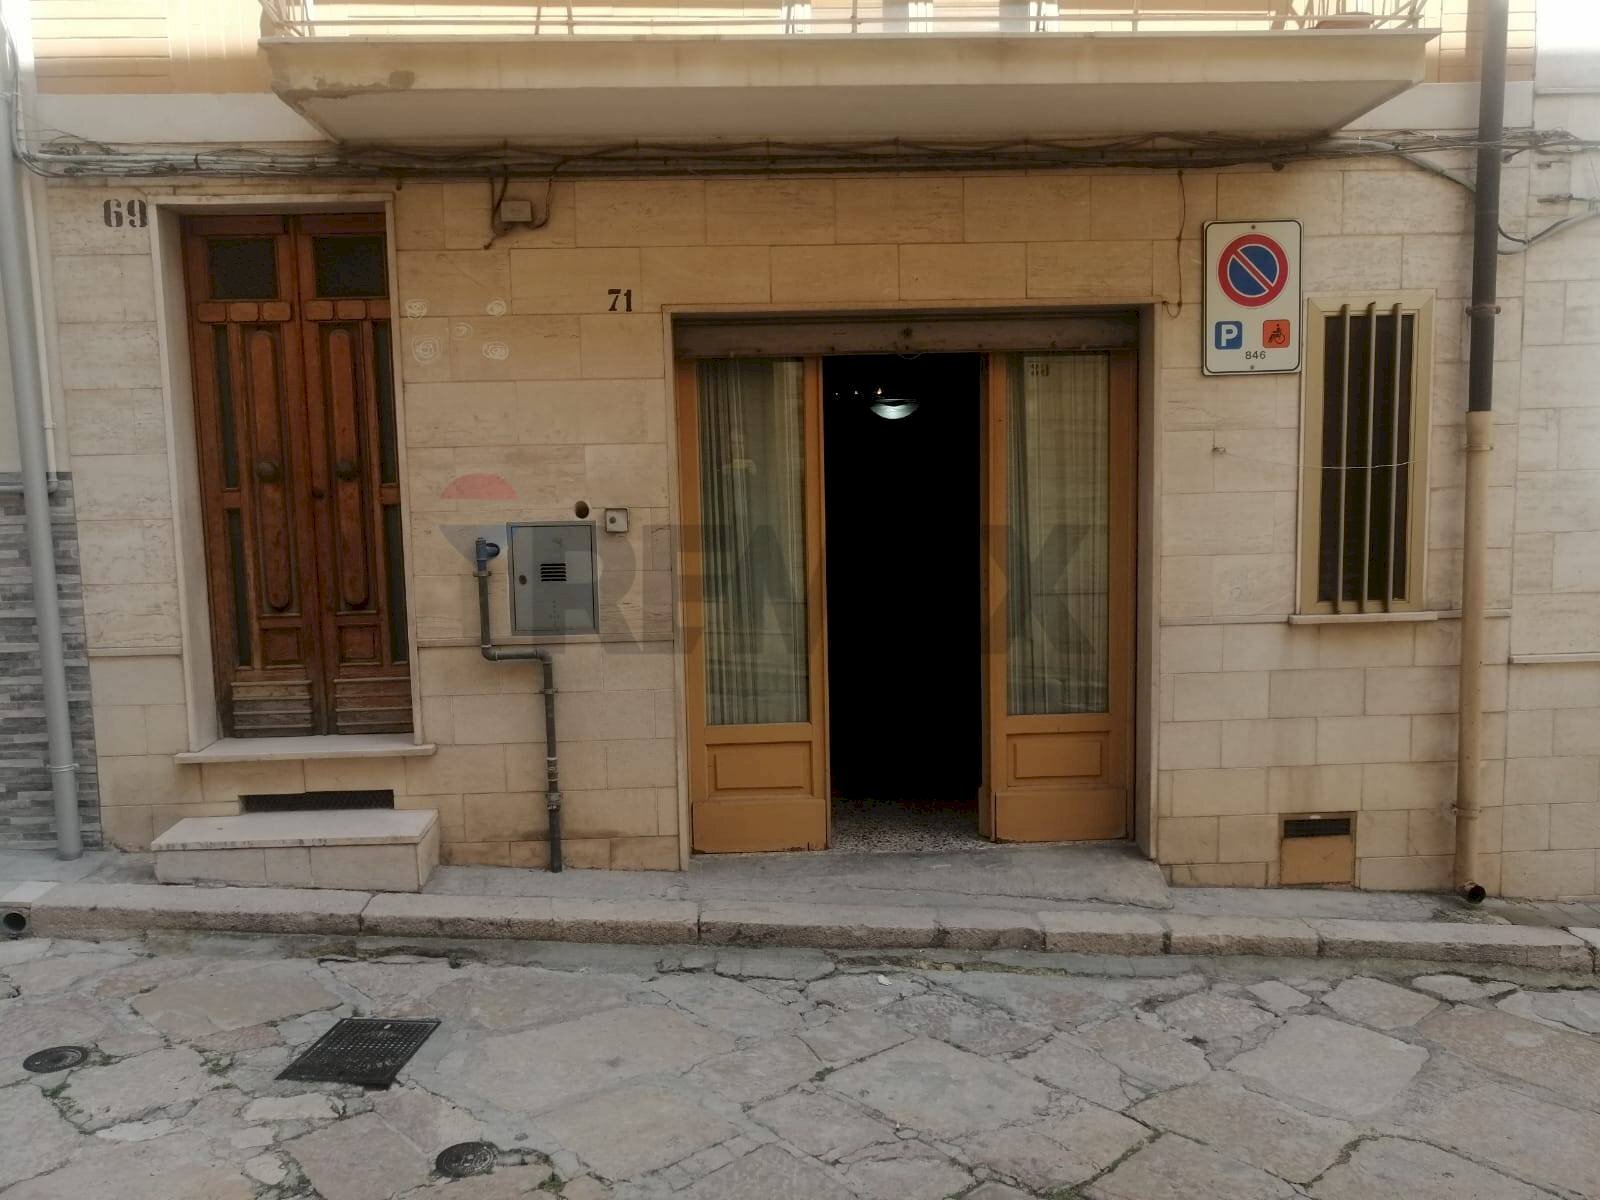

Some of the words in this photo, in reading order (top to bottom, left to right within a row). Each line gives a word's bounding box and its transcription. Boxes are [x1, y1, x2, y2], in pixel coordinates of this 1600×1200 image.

[103, 199, 148, 228] 69
[607, 288, 633, 312] 71
[1221, 324, 1239, 347] P
[1245, 350, 1267, 360] 846
